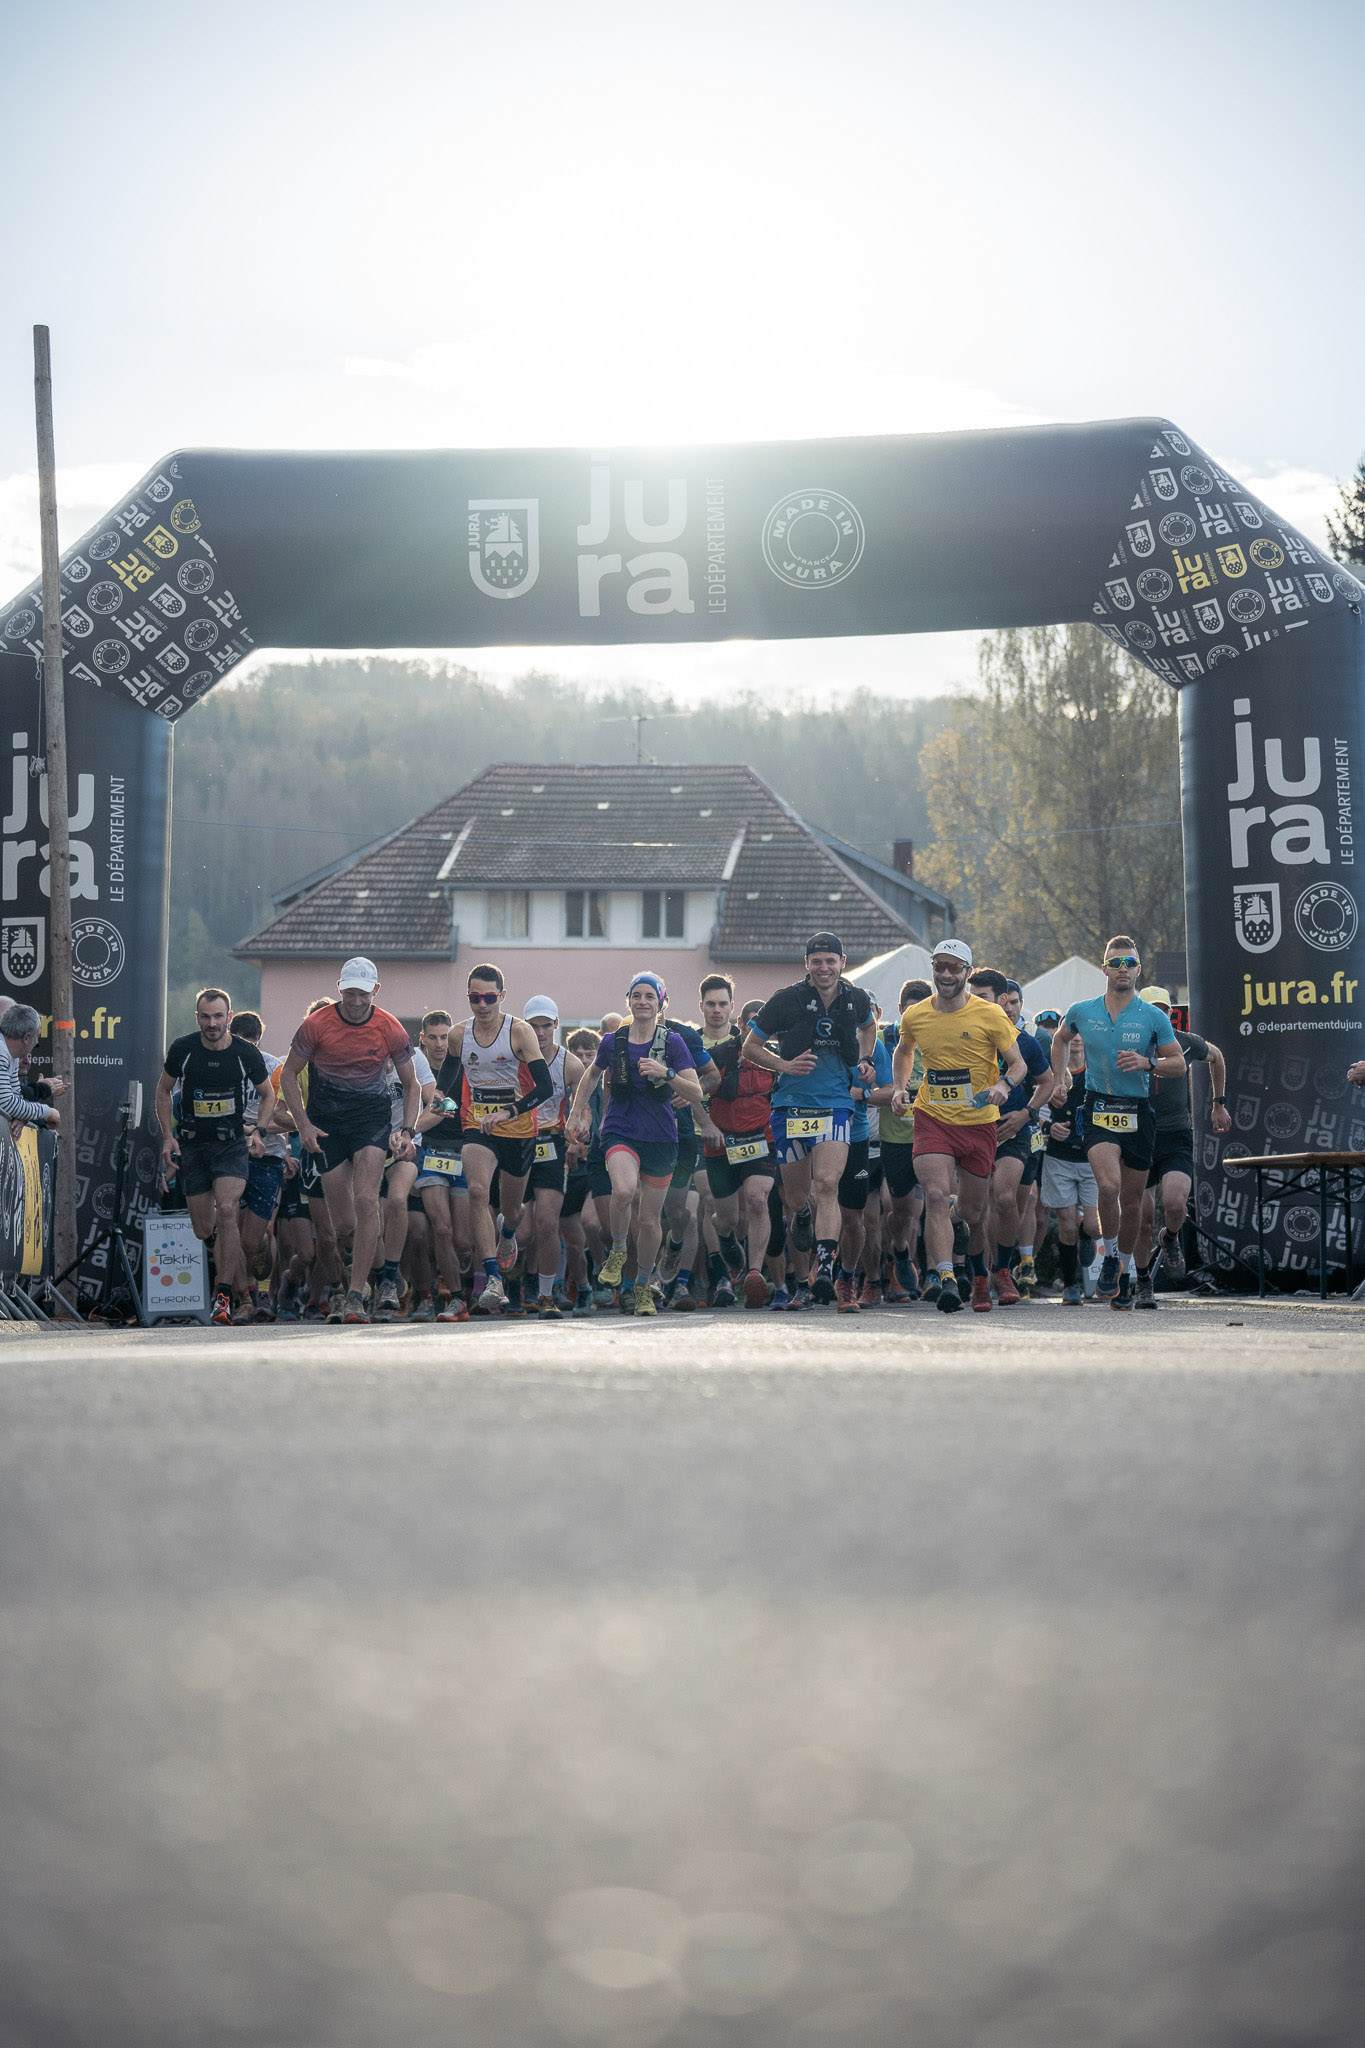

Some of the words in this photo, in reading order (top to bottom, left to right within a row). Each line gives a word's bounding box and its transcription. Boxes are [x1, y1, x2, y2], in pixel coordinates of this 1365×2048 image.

[577, 452, 687, 546] ju
[1194, 497, 1224, 522] ju
[773, 499, 830, 539] MADE
[836, 510, 854, 536] IN
[1163, 516, 1180, 532] MADE
[1183, 516, 1190, 526] IN
[1202, 519, 1233, 538] ra
[468, 512, 480, 549] JURA
[704, 477, 726, 594] DÉPARTEMENT
[1169, 533, 1190, 542] JURA
[106, 553, 139, 580] ju
[782, 560, 844, 580] JURA
[796, 555, 830, 566] FRANCE
[1172, 549, 1203, 577] ju
[123, 565, 154, 592] ra
[577, 551, 694, 616] ra
[1140, 572, 1157, 589] MADE
[1178, 571, 1211, 594] ra
[1264, 572, 1294, 598] ju
[1146, 589, 1168, 599] JURA
[1232, 592, 1249, 610] MADE
[1270, 594, 1303, 614] ra
[708, 598, 726, 613] LE
[1238, 609, 1260, 620] JURA
[110, 610, 146, 640] ju
[1151, 606, 1181, 632] ju
[130, 624, 162, 652] ra
[1160, 628, 1190, 646] ra
[118, 670, 151, 698] ju
[135, 682, 164, 706] ra
[1228, 698, 1322, 802] ju
[1335, 738, 1353, 844] DÉPARTEMENT
[106, 775, 124, 882] DÉPARTEMENT
[1228, 804, 1331, 868] ra
[1341, 850, 1354, 864] LE
[110, 886, 124, 902] LE
[1302, 889, 1338, 916] MADE
[1342, 898, 1352, 916] IN
[1234, 894, 1242, 920] JURA
[108, 936, 118, 952] IN
[1309, 930, 1348, 944] JURA
[72, 965, 112, 980] JURA
[1241, 971, 1358, 1016] jura.fr
[1257, 1019, 1362, 1034] @departementdujura
[942, 1088, 958, 1098] 85
[206, 1102, 222, 1112] 71
[1308, 1098, 1338, 1130] ju
[802, 1120, 819, 1132] 34
[1104, 1115, 1128, 1126] 196
[1304, 1126, 1334, 1149] ra
[740, 1145, 756, 1156] 30
[436, 1160, 450, 1170] 31
[1218, 1178, 1241, 1208] ju
[1216, 1206, 1238, 1228] ra
[1288, 1210, 1310, 1221] MADE
[1290, 1228, 1312, 1238] JURA
[155, 1254, 200, 1265] Taktik
[1278, 1241, 1308, 1270] ju
[150, 1295, 200, 1304] CHRONO
